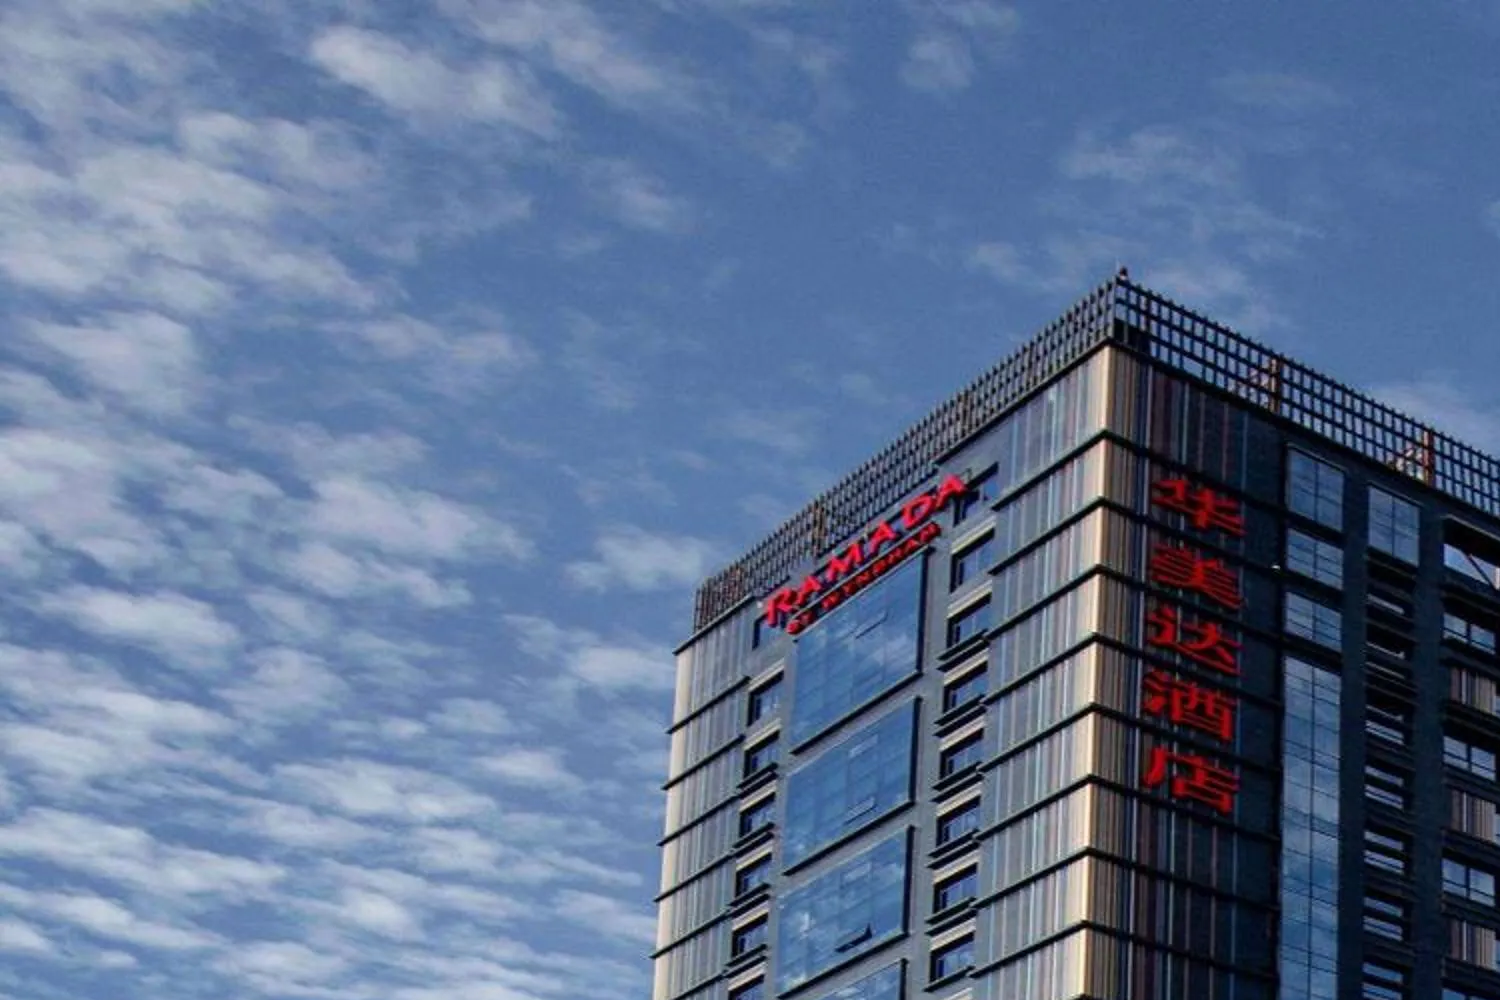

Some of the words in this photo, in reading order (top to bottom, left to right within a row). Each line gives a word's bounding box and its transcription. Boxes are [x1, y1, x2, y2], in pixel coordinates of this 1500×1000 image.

[767, 474, 966, 628] RAMADA
[1143, 478, 1246, 814] 华美达酒店
